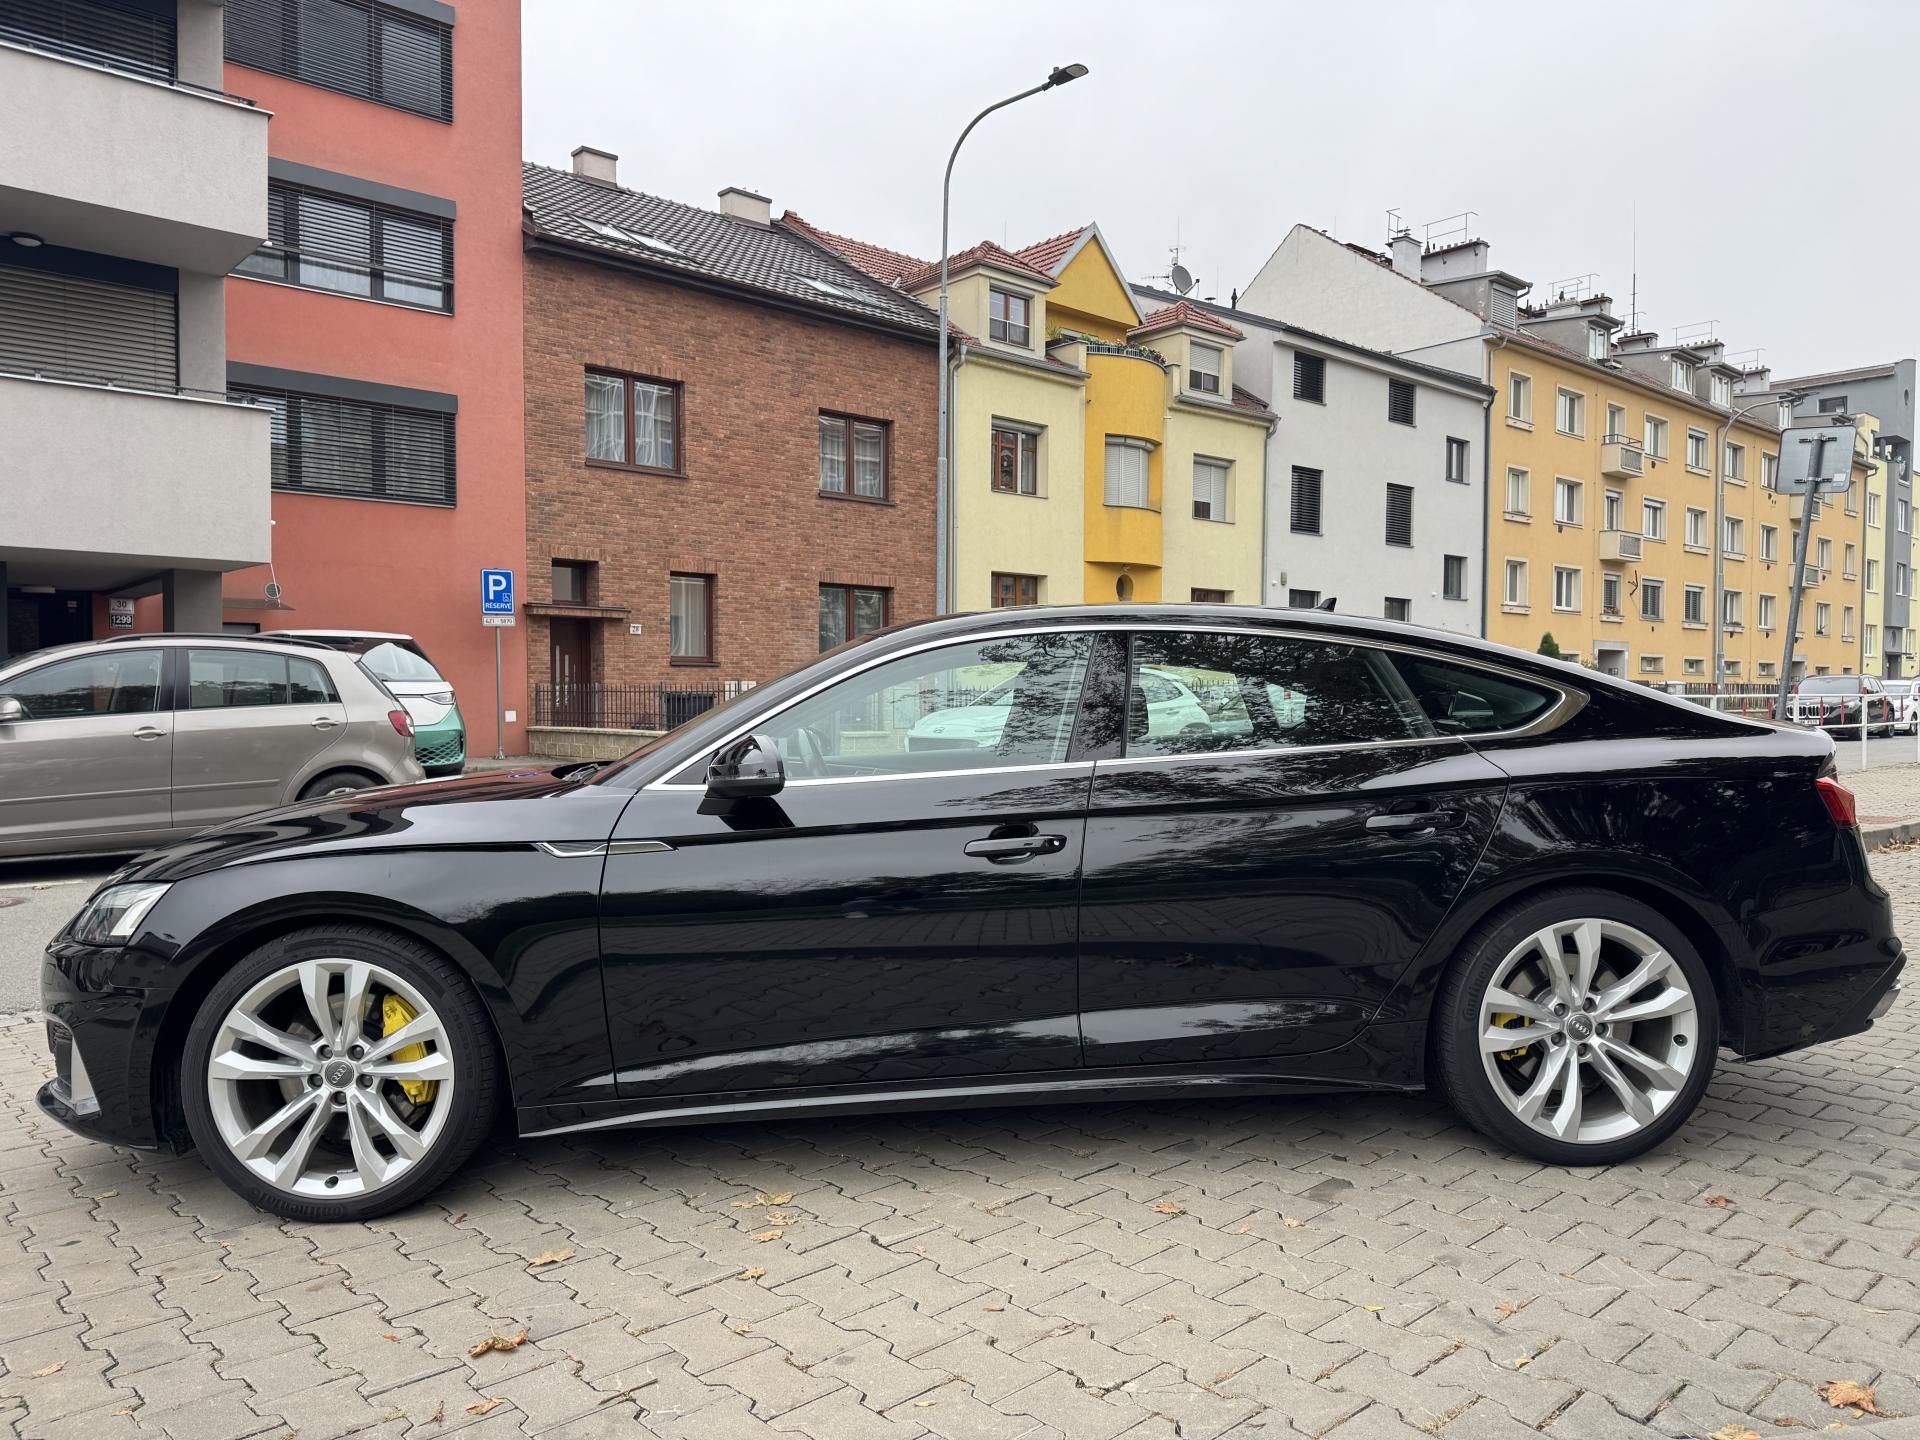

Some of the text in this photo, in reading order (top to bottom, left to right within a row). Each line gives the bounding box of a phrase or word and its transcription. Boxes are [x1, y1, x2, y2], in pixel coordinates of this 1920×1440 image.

[489, 574, 506, 600] P
[117, 600, 127, 608] 30
[112, 615, 132, 624] 1299
